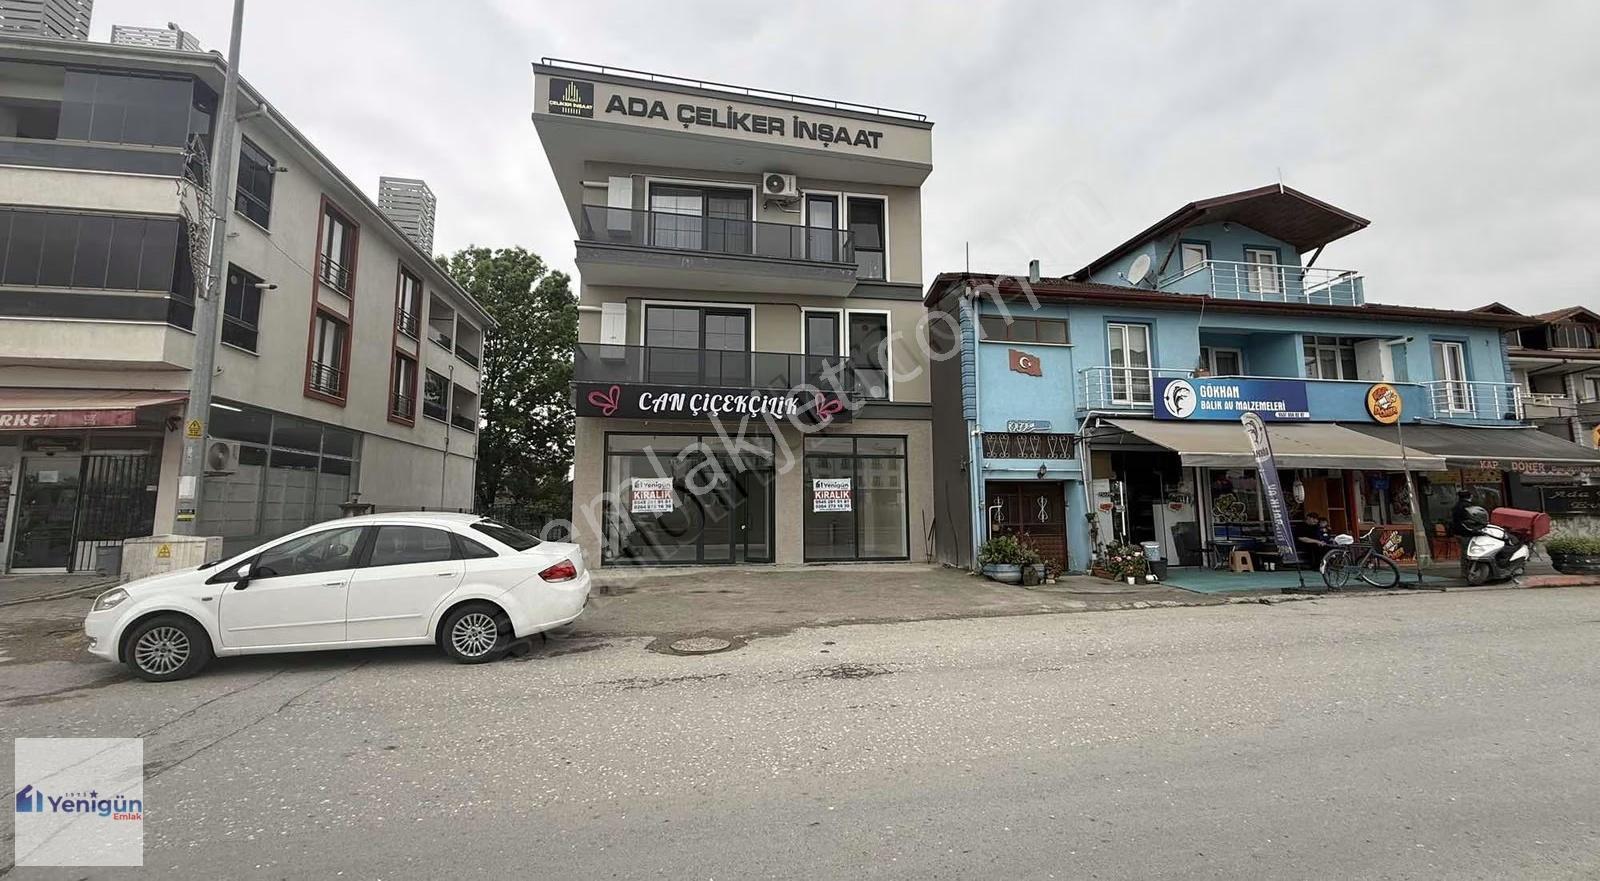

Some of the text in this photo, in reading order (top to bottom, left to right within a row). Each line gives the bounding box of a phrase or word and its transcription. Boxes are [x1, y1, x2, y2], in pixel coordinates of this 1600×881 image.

[605, 94, 884, 149] ADA ÇELİKER İNŞAAT
[1200, 384, 1239, 398] GÖKHAN
[638, 392, 798, 420] CAN ÇİÇEKÇİLİK
[1201, 400, 1286, 411] BALIK AV MALZEMELERİ
[1480, 460, 1498, 469] KAP
[633, 490, 671, 500] KİRALIK
[815, 490, 849, 499] KİRALIK
